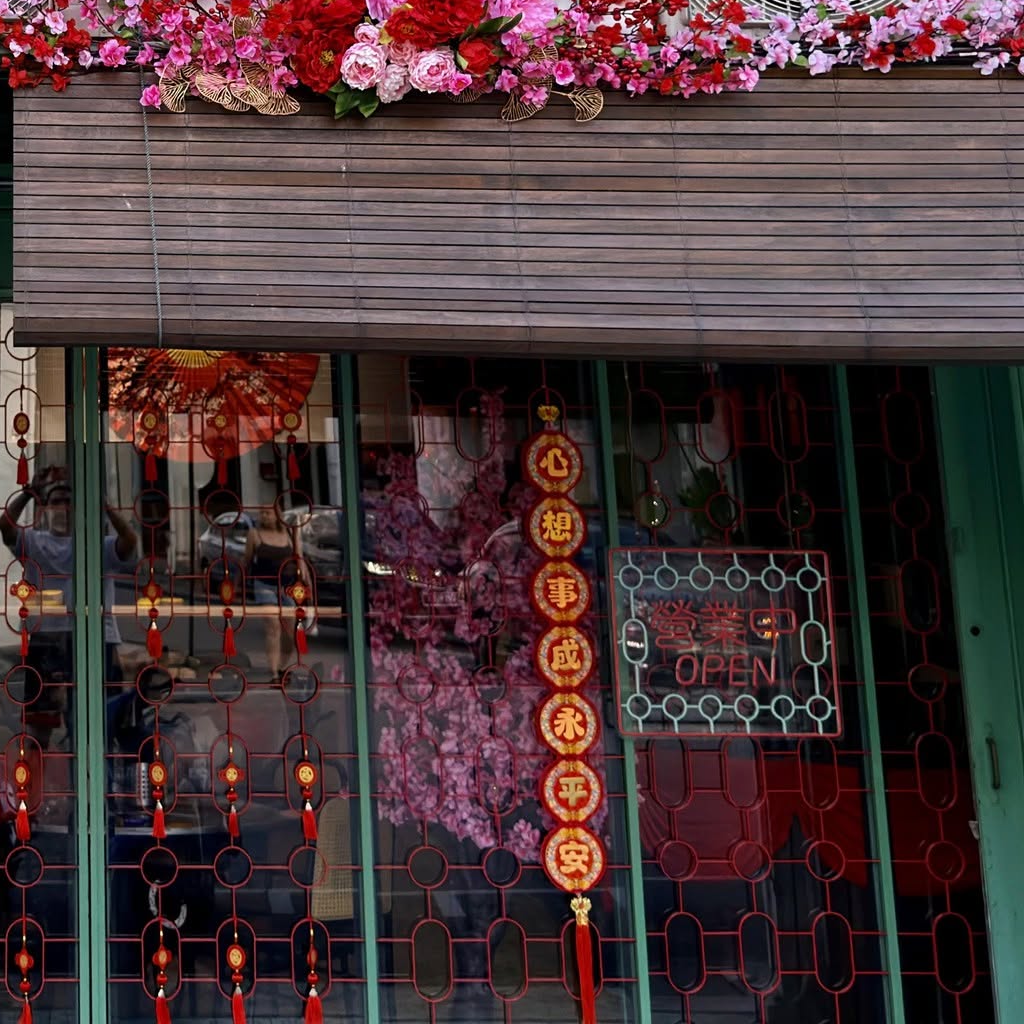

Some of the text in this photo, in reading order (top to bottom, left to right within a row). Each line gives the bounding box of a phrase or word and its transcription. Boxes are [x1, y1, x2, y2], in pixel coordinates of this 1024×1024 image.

[651, 599, 796, 654] 營業中
[676, 655, 776, 686] OPEN
